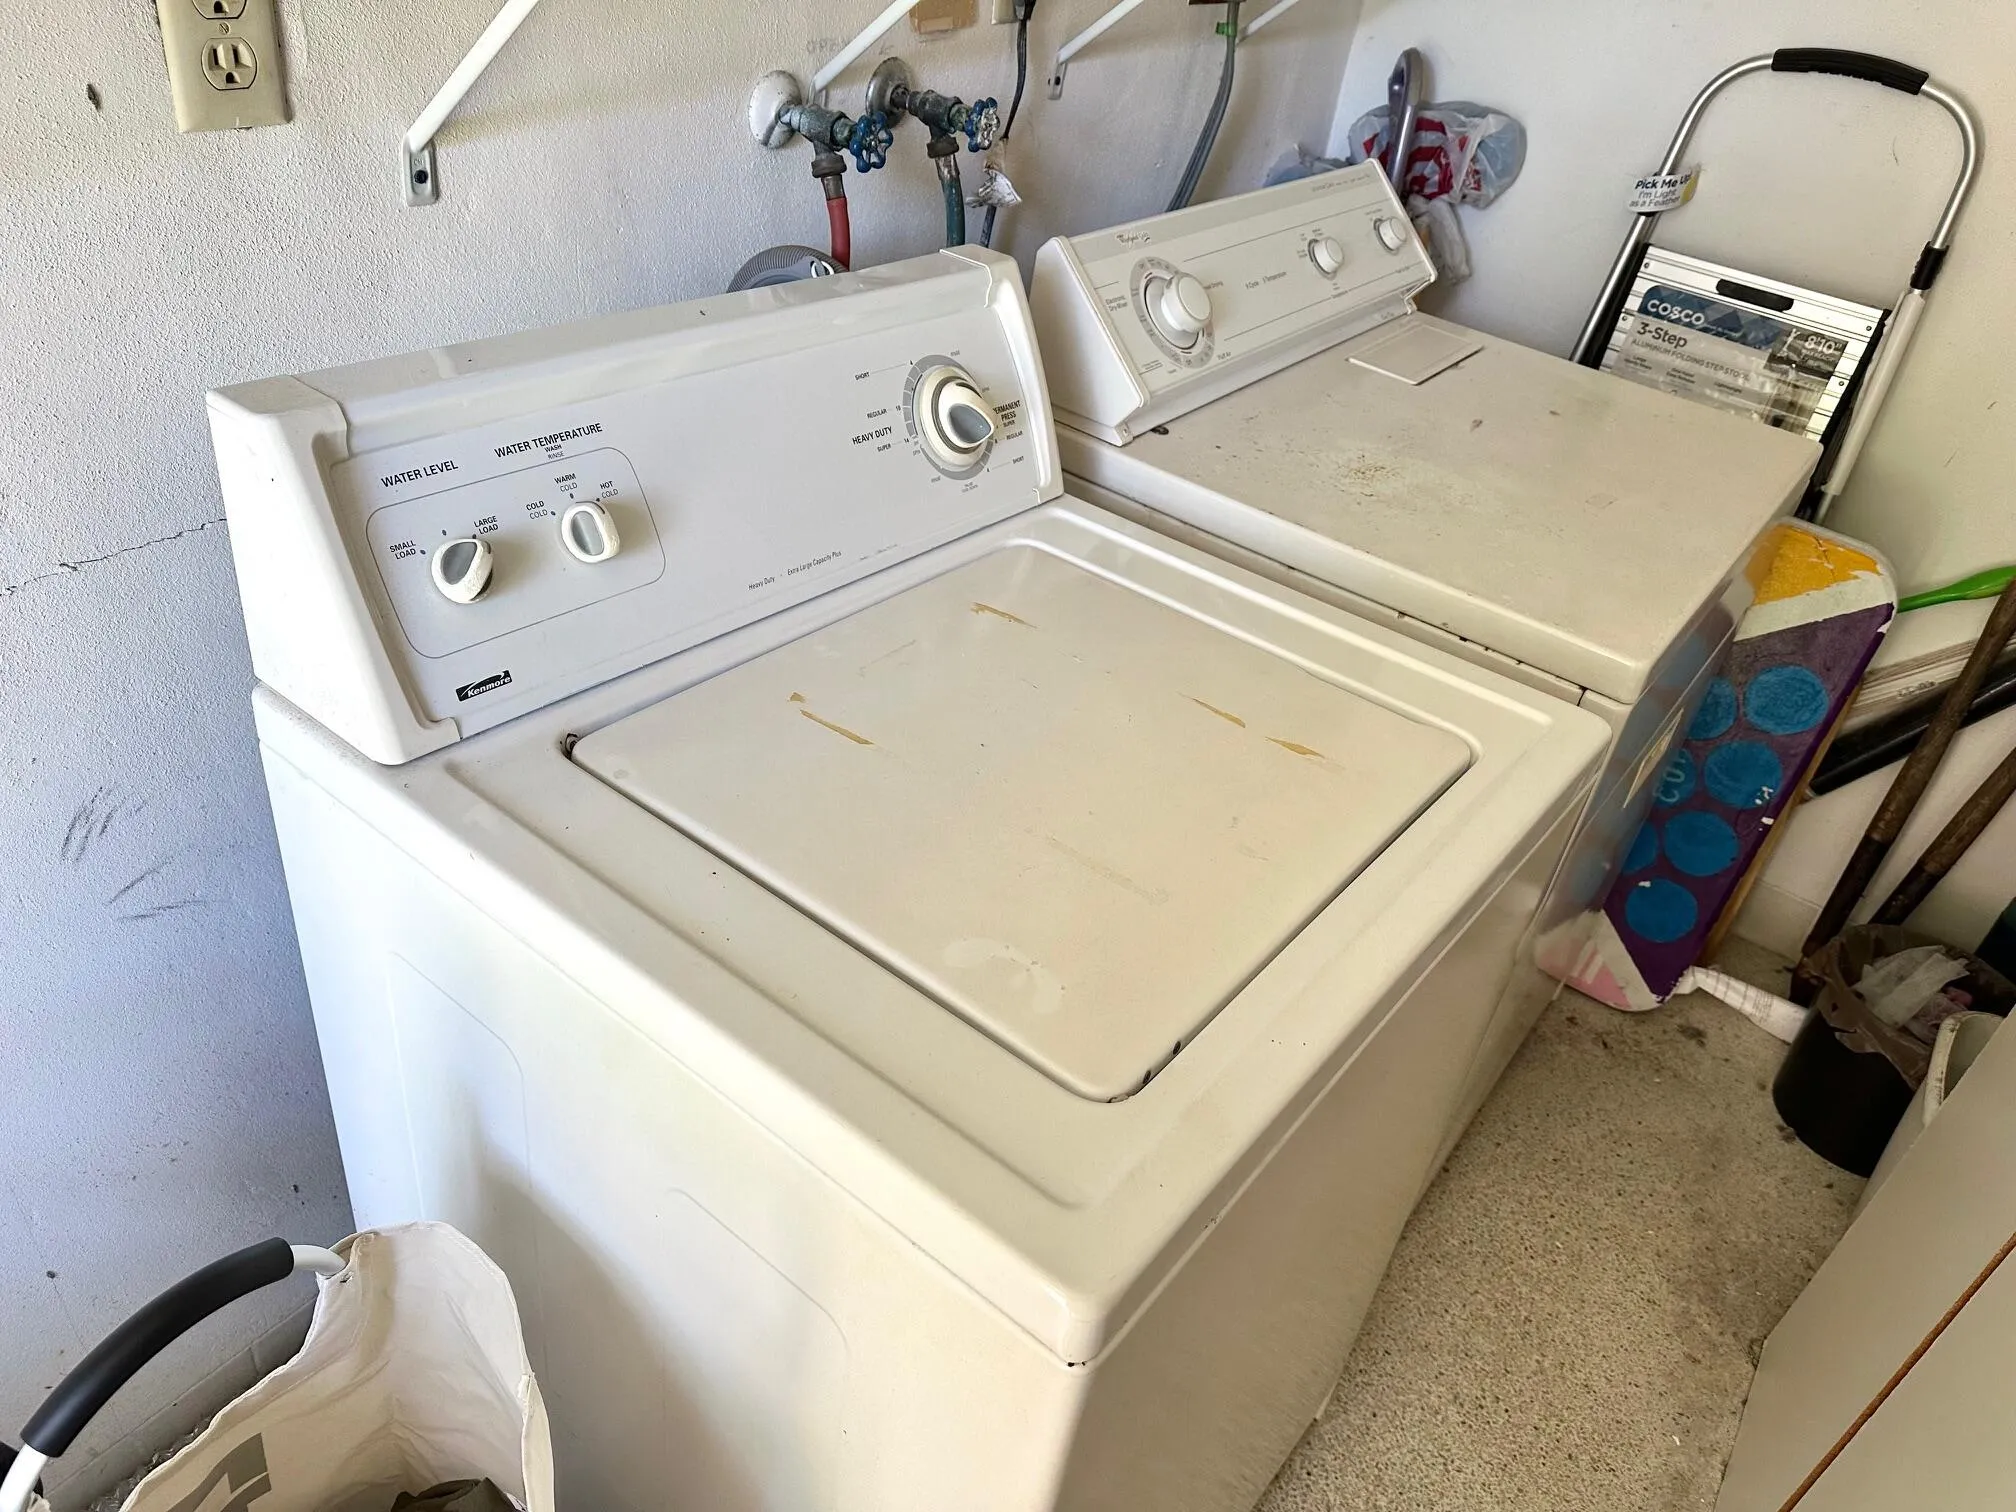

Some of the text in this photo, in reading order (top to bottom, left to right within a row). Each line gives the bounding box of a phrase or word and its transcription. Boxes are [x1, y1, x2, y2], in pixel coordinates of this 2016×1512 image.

[1635, 179, 1659, 189] Pick
[1661, 179, 1677, 188] Me
[1654, 189, 1677, 199] Light
[1647, 196, 1680, 207] Feather
[1647, 299, 1704, 325] COSCO
[1637, 321, 1687, 349] 3-Step
[1704, 361, 1724, 372] STEP
[855, 371, 870, 380] SHORT
[992, 400, 1021, 414] ERMANENT
[867, 408, 887, 419] REGULAR
[1001, 411, 1017, 422] PRESS
[494, 423, 603, 458] WATER TEMPERATURE
[852, 426, 893, 445] HEAVY DUTY
[1006, 430, 1023, 440] REGULAR
[544, 444, 562, 453] WASH
[877, 443, 891, 452] SUPER
[547, 451, 565, 460] RINSE
[1012, 456, 1025, 464] SHORT
[381, 460, 458, 487] WATER LEVEL
[554, 473, 577, 484] WARM
[560, 482, 578, 492] COLD
[600, 480, 614, 489] HOT
[601, 488, 619, 499] COLD
[526, 500, 545, 511] COLD
[529, 509, 548, 520] COLD
[474, 515, 498, 528] LARGE
[479, 524, 499, 535] LOAD
[389, 540, 417, 553] SMALL
[395, 548, 417, 560] LOAD
[748, 581, 764, 590] Heavy
[764, 576, 775, 585] Duty
[788, 568, 799, 576] Extra
[800, 562, 812, 571] Large
[813, 554, 831, 566] Capacity
[467, 677, 511, 698] Kenmore
